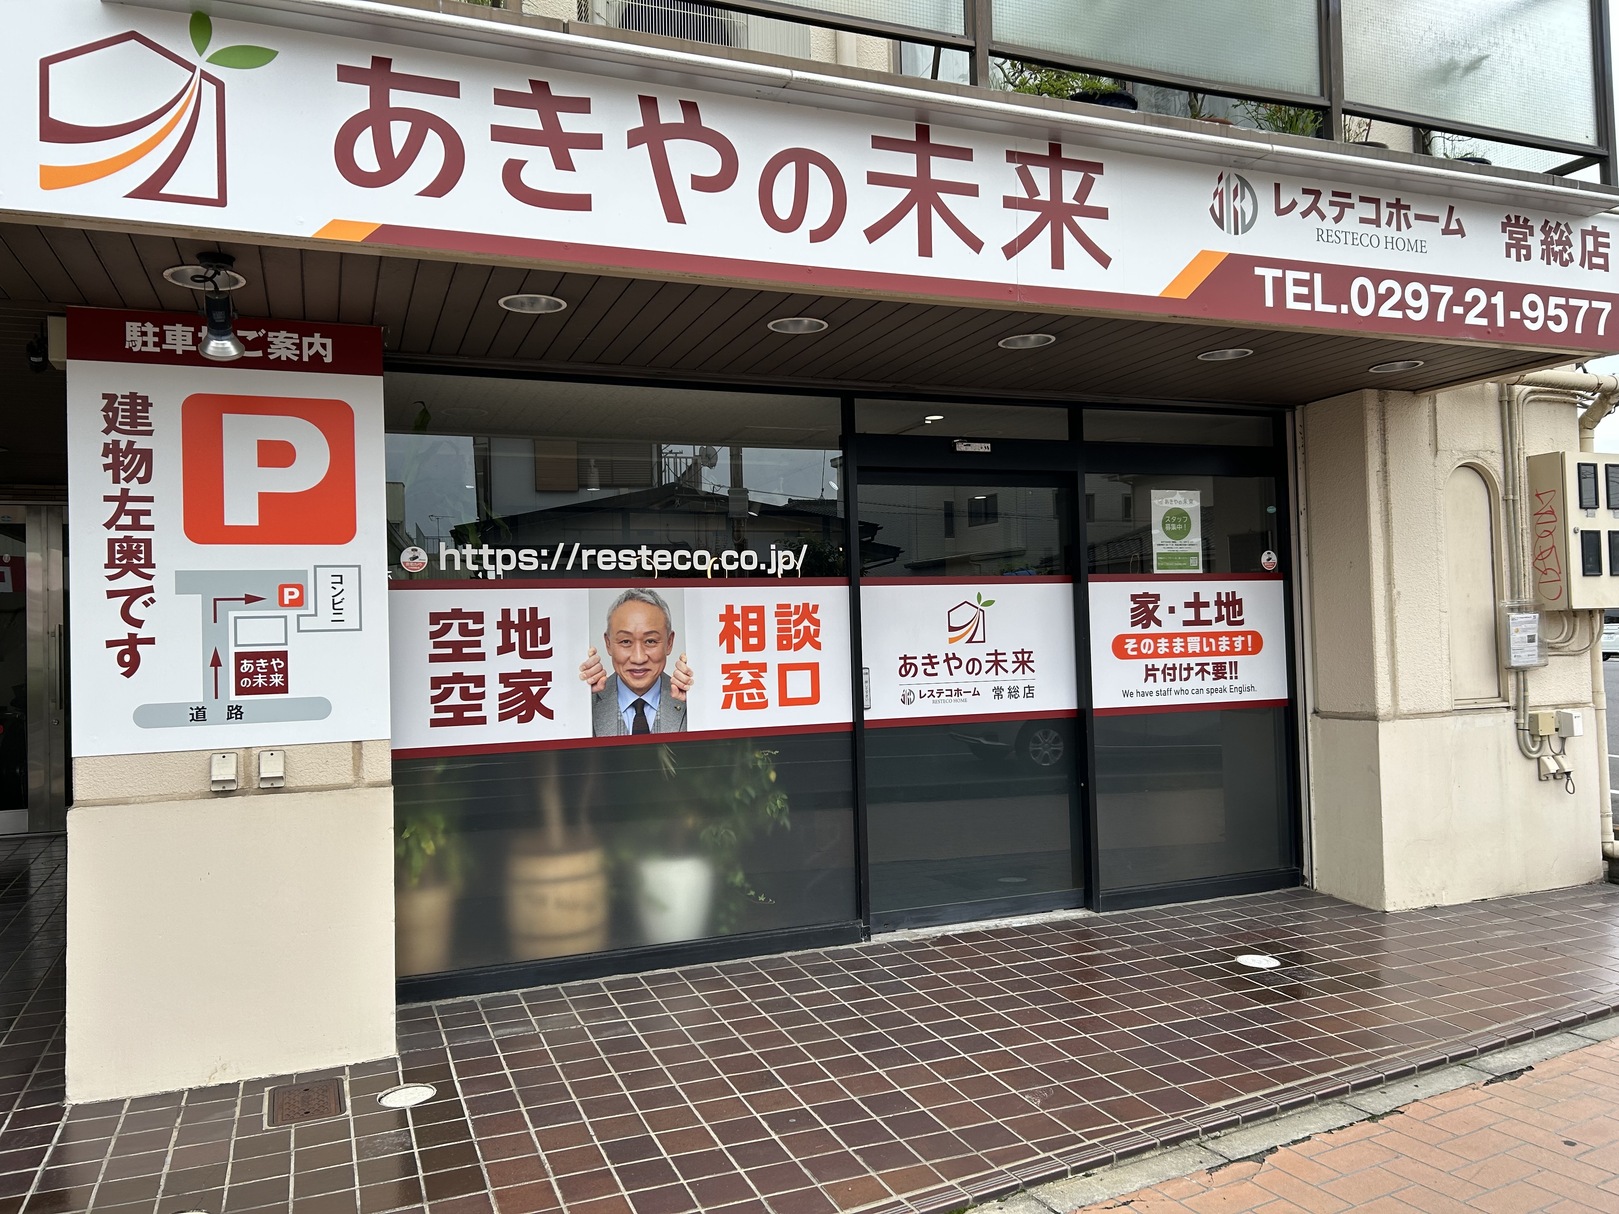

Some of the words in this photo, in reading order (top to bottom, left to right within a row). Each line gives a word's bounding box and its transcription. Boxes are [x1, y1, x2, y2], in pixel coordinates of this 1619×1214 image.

[334, 55, 1112, 271] あきやの未来
[1273, 182, 1467, 239] レステコホーム
[1500, 213, 1611, 273] 常総店
[1316, 227, 1380, 250] RESTECO
[1384, 235, 1428, 254] HOME
[1254, 266, 1612, 336] TEL.0297-21-9577
[125, 321, 333, 363] 駐車ご案内
[222, 413, 331, 526] P
[101, 391, 156, 679] 建物左奥です
[439, 541, 808, 575] https://resteco.co.jp/
[283, 587, 300, 605] P
[330, 573, 345, 623] コンビニ
[428, 606, 554, 664] 空地
[718, 602, 822, 654] 相談
[1123, 635, 1252, 656] そのまま買います!
[240, 657, 285, 673] あきや
[240, 672, 285, 688] の未来
[898, 648, 1036, 678] あきやの未来
[1143, 660, 1238, 683] 片付け不要!!
[429, 668, 555, 728] 空家
[720, 660, 821, 711] 窓口
[918, 687, 980, 699] レステコホーム
[991, 685, 1035, 700] 常総店
[1122, 689, 1134, 699] We
[1136, 688, 1154, 698] have
[1155, 687, 1172, 697] staff
[1174, 686, 1189, 696] who
[1191, 686, 1204, 695] can
[1206, 684, 1227, 696] speak
[1229, 683, 1257, 694] English.
